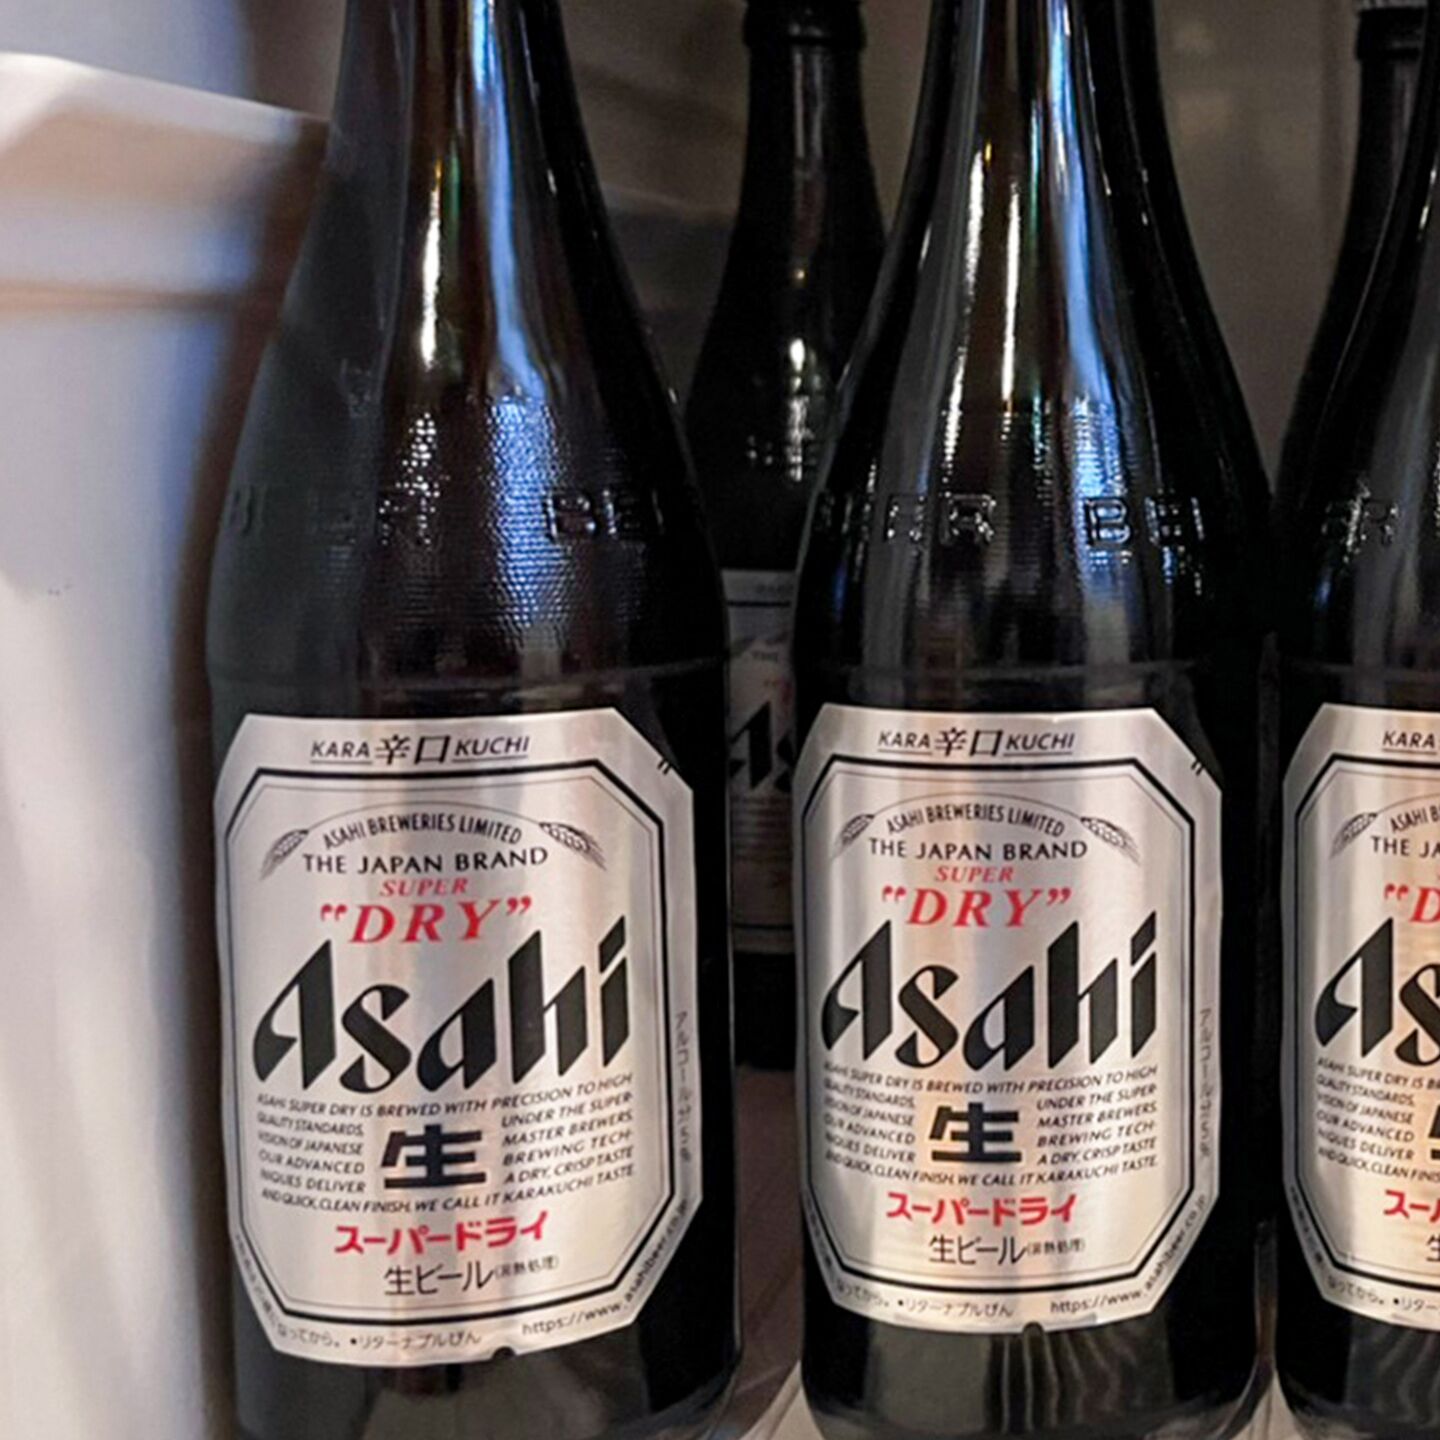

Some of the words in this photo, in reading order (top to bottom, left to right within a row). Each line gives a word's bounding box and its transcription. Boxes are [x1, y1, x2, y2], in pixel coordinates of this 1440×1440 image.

[310, 740, 371, 758] KARA
[375, 734, 452, 765] 辛口
[454, 736, 530, 756] KUCHI
[877, 730, 931, 749] KARA
[935, 727, 1003, 757] 辛口
[1005, 731, 1076, 749] KUCHI
[1382, 730, 1436, 749] KARA
[324, 821, 366, 849] ASAHI
[368, 813, 455, 836] BREWERIES
[459, 817, 523, 845] LIMITED
[887, 809, 924, 835] ASAHI
[927, 804, 1004, 824] BREWERIES
[1007, 807, 1066, 836] LIMITED
[1391, 807, 1428, 834] ASAHI
[303, 853, 347, 874] THE
[357, 854, 443, 875] JAPAN
[455, 847, 549, 872] BRAND
[869, 838, 908, 858] THE
[915, 842, 993, 861] JAPAN
[1004, 841, 1088, 861] BRAND
[1371, 836, 1411, 856] THE
[379, 877, 469, 897] SUPER
[934, 865, 1014, 882] SUPER
[253, 915, 630, 1093] Asahi
[821, 910, 1157, 1071] Asahi
[929, 1102, 1022, 1164] 生
[380, 1124, 487, 1190] 生
[886, 1191, 1077, 1227] スーパードライ
[334, 1211, 549, 1256] スーパードライ
[929, 1234, 1026, 1265] 生ビール
[383, 1261, 494, 1297] 生ビール
